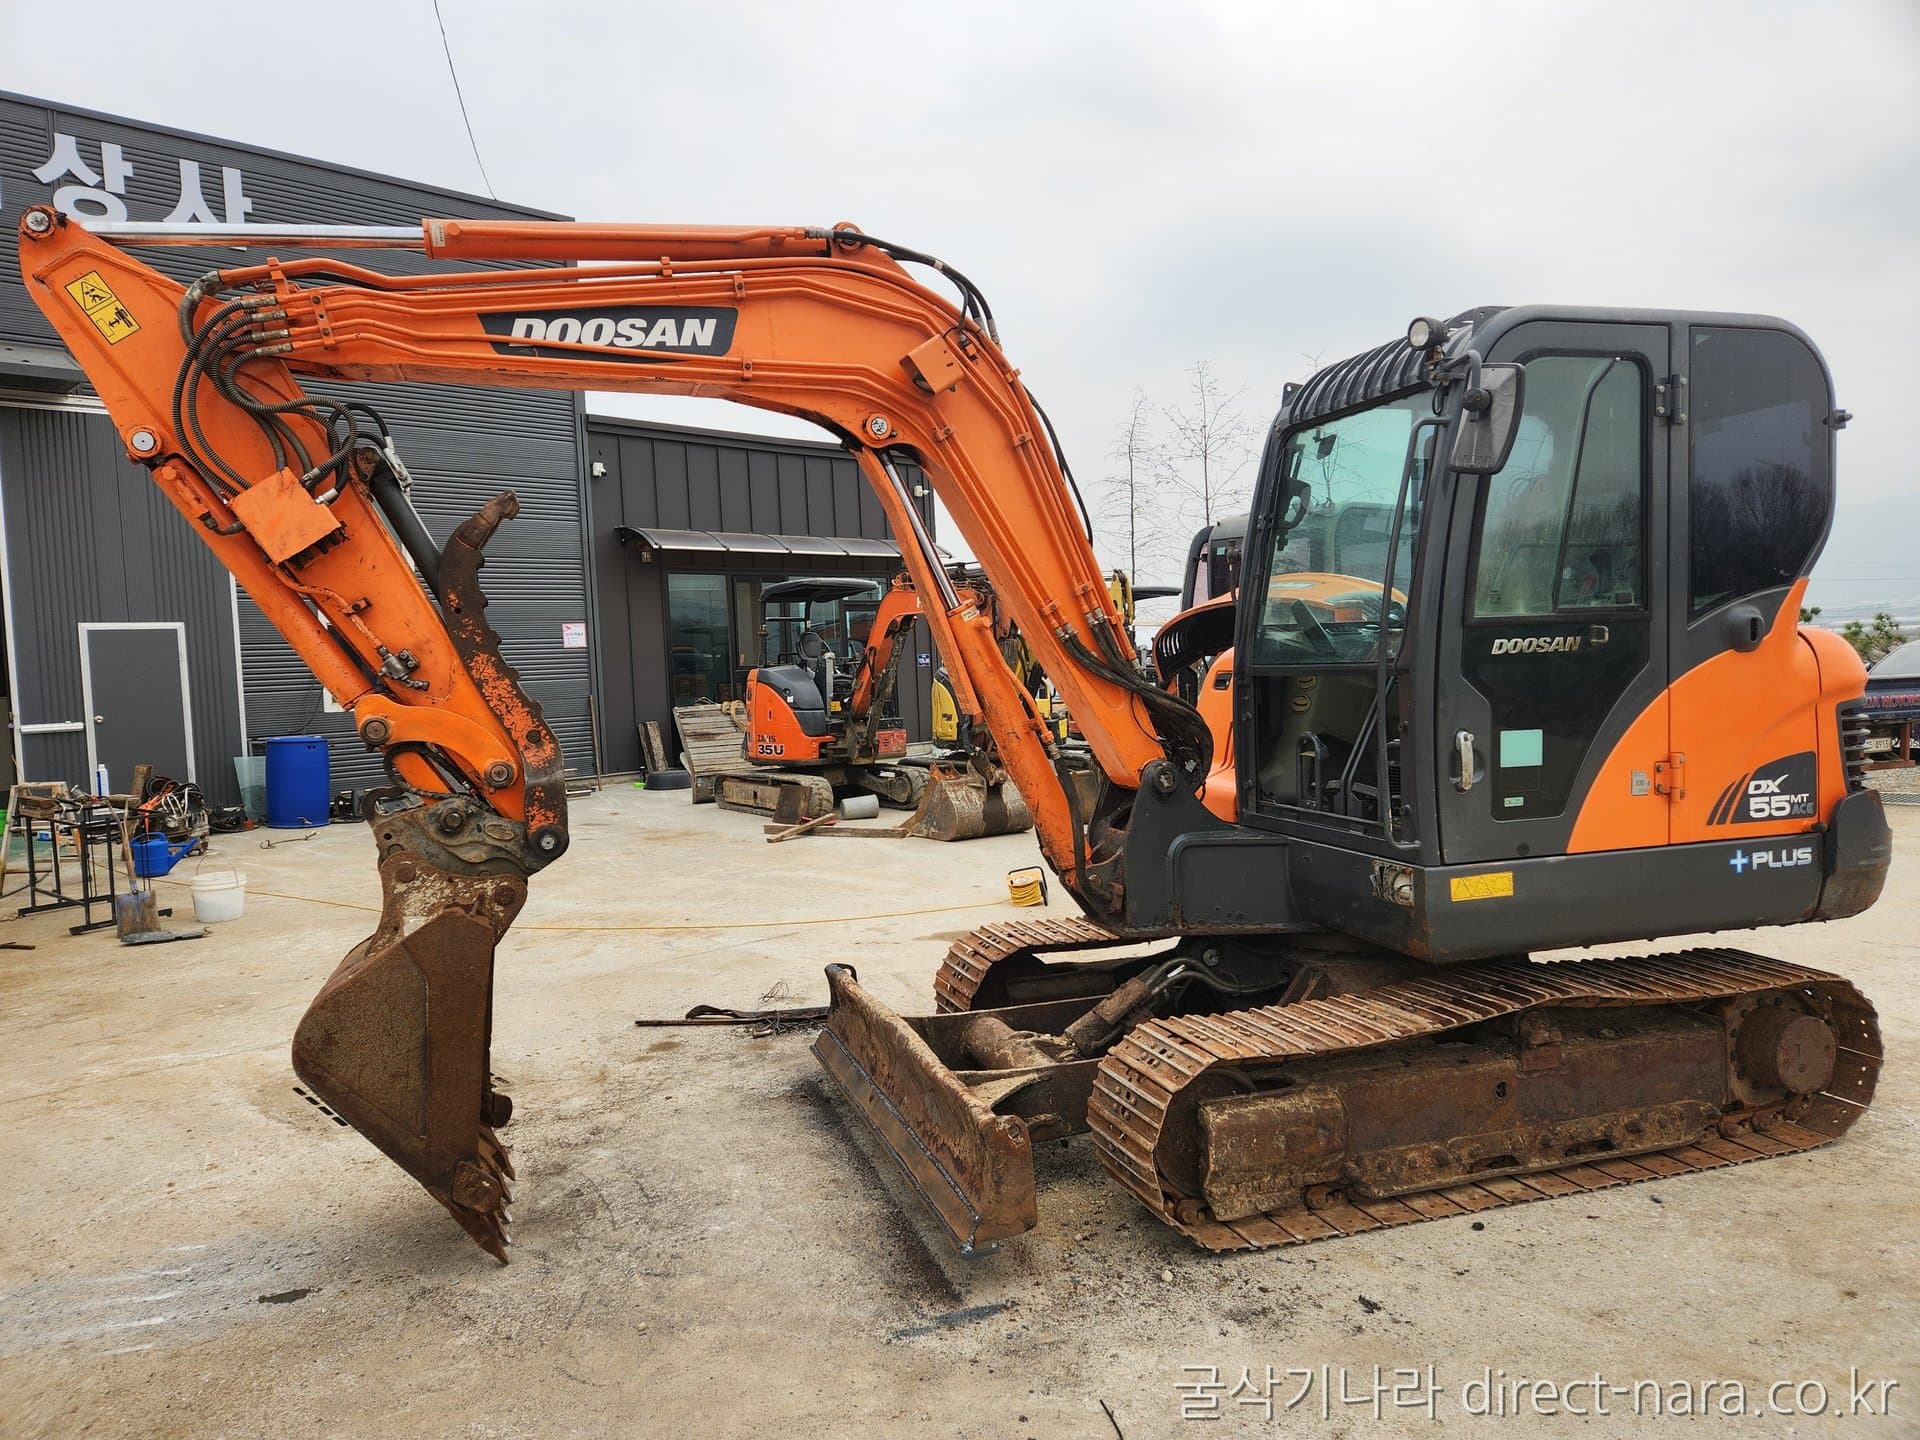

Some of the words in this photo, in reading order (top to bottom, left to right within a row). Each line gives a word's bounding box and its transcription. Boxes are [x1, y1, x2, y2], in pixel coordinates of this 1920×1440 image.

[508, 317, 718, 347] DOOSAN
[1491, 636, 1581, 655] DOOSAN
[758, 744, 784, 756] 35U
[1747, 774, 1790, 795] DX
